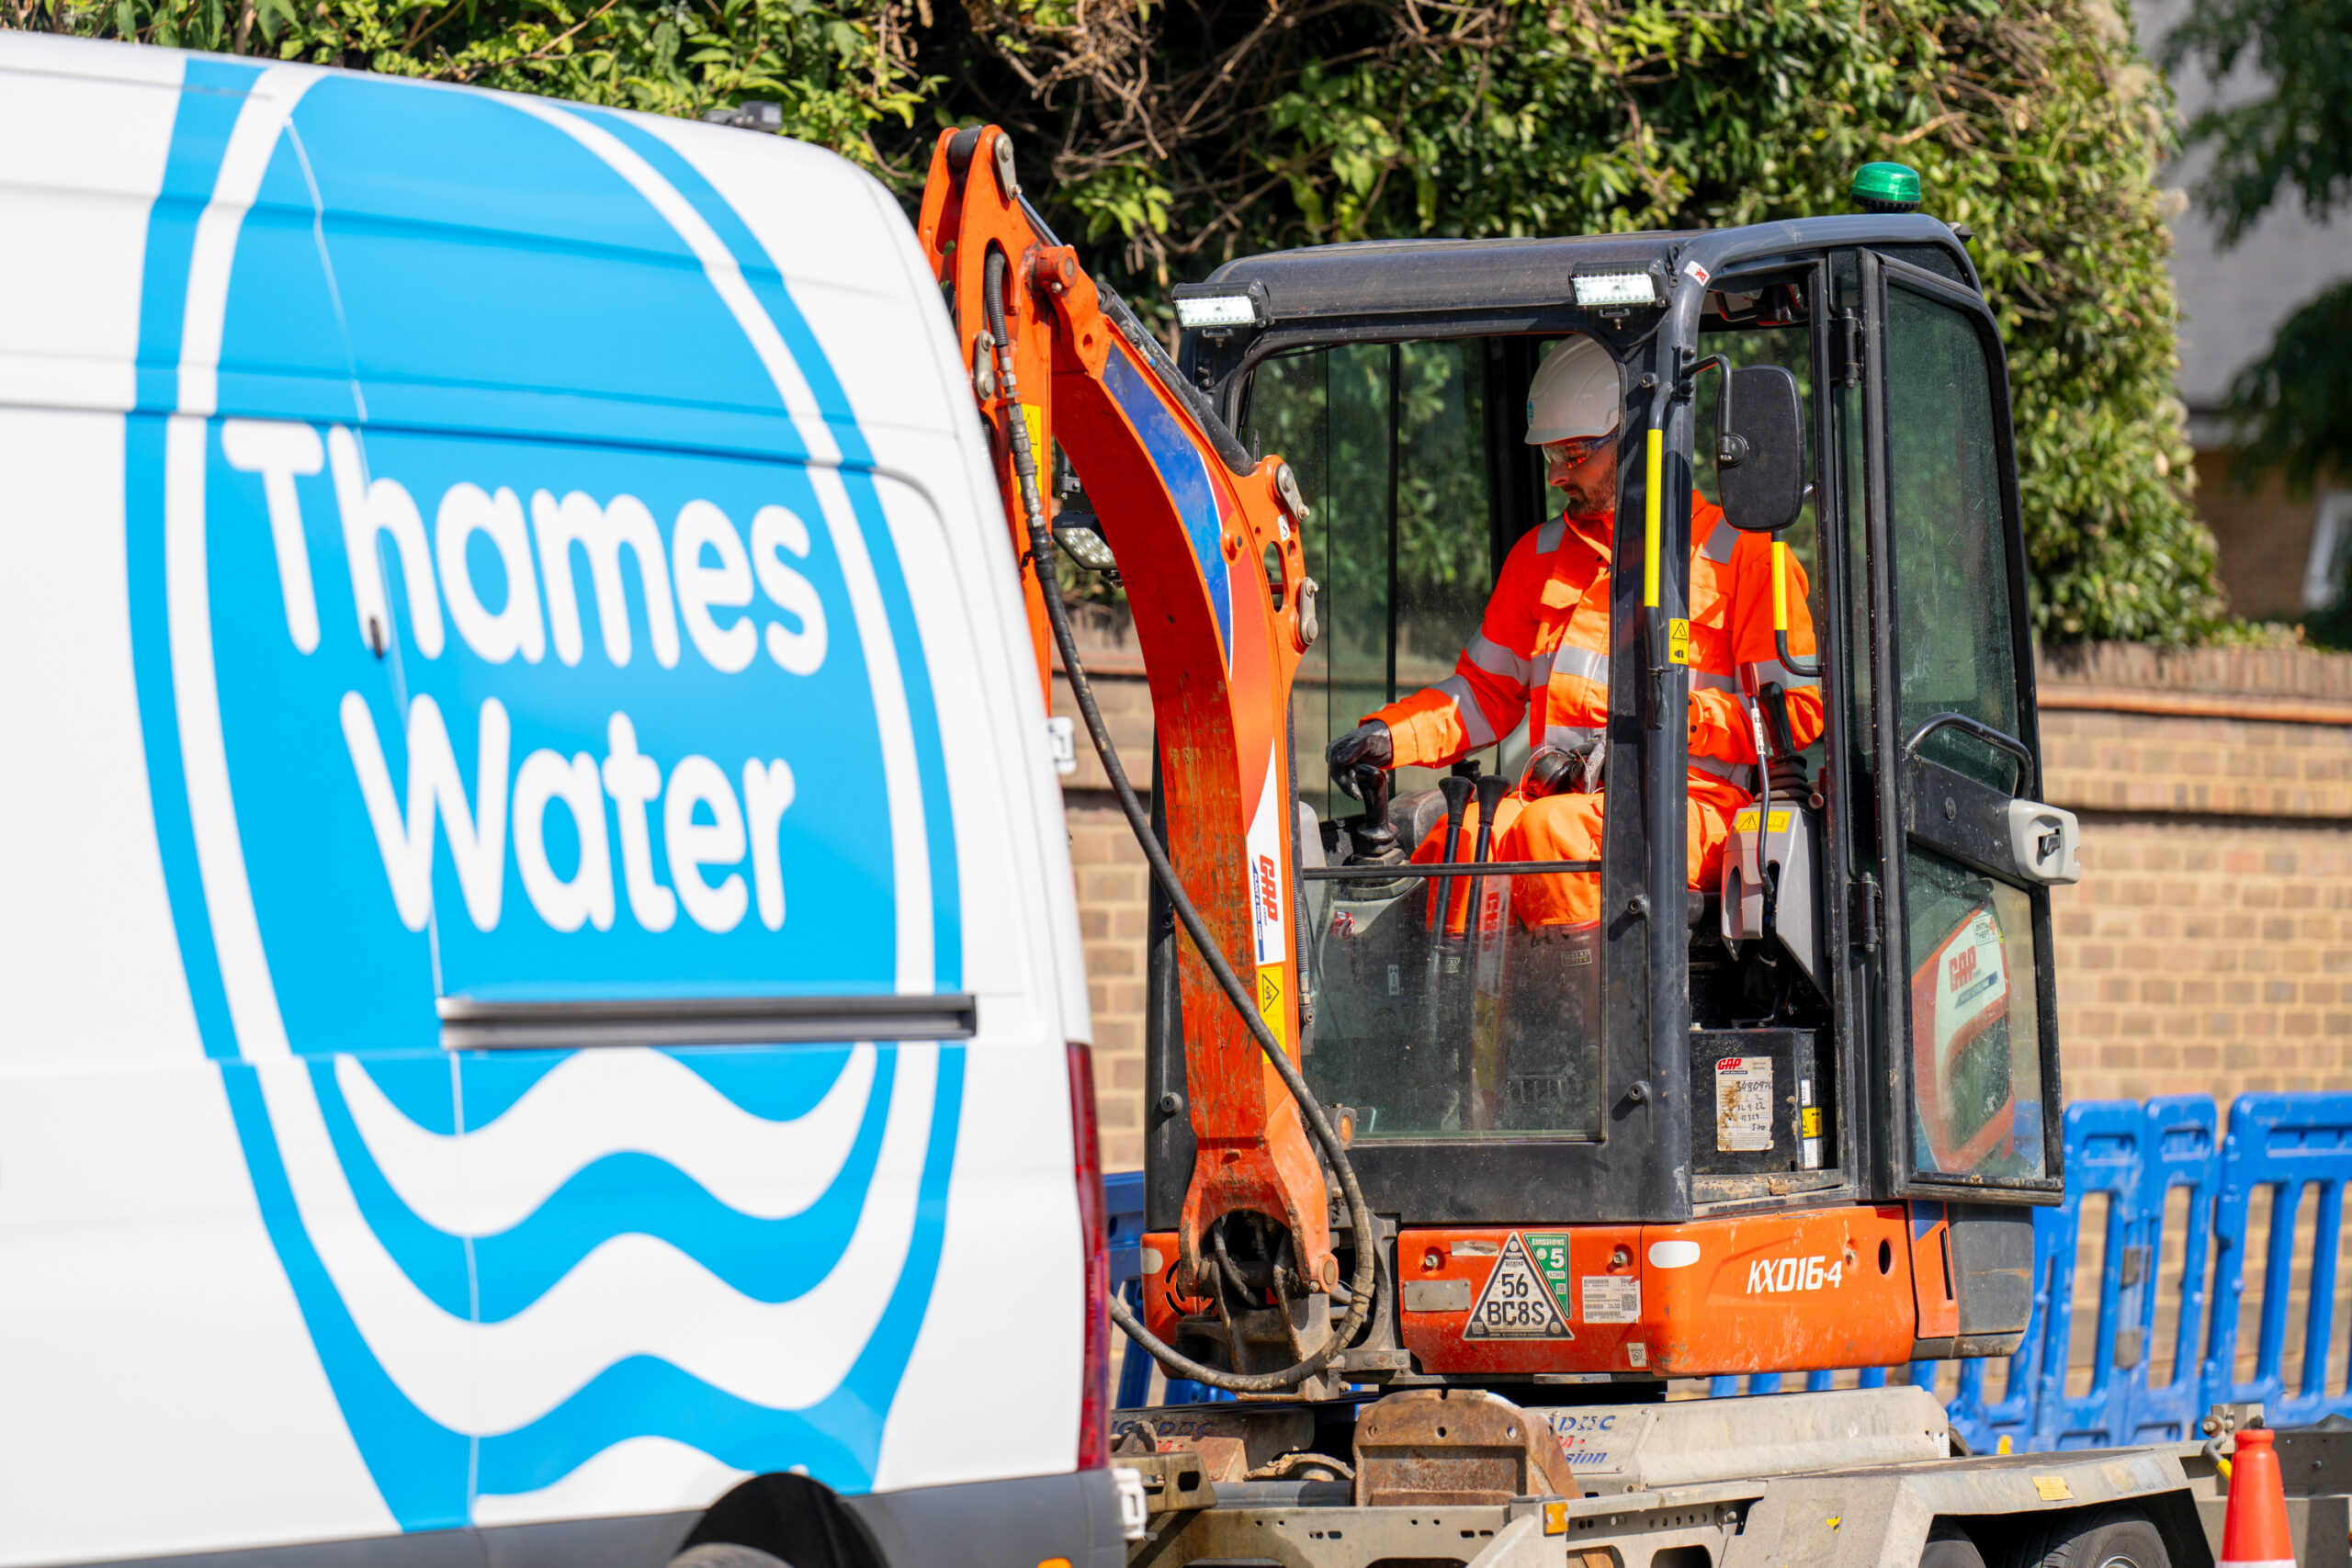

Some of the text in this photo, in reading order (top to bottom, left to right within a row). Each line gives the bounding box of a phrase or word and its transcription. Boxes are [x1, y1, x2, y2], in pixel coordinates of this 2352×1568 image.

[221, 419, 828, 676] Thames
[340, 690, 796, 934] Water
[1260, 854, 1278, 922] GAP
[1949, 945, 1977, 993] GAP
[1717, 1058, 1742, 1070] GAP
[1532, 1237, 1566, 1247] EMISSIONS
[1550, 1247, 1566, 1269] 5
[1501, 1273, 1529, 1298] 56
[1747, 1255, 1843, 1294] KX016-4
[1487, 1301, 1545, 1325] BC8S
